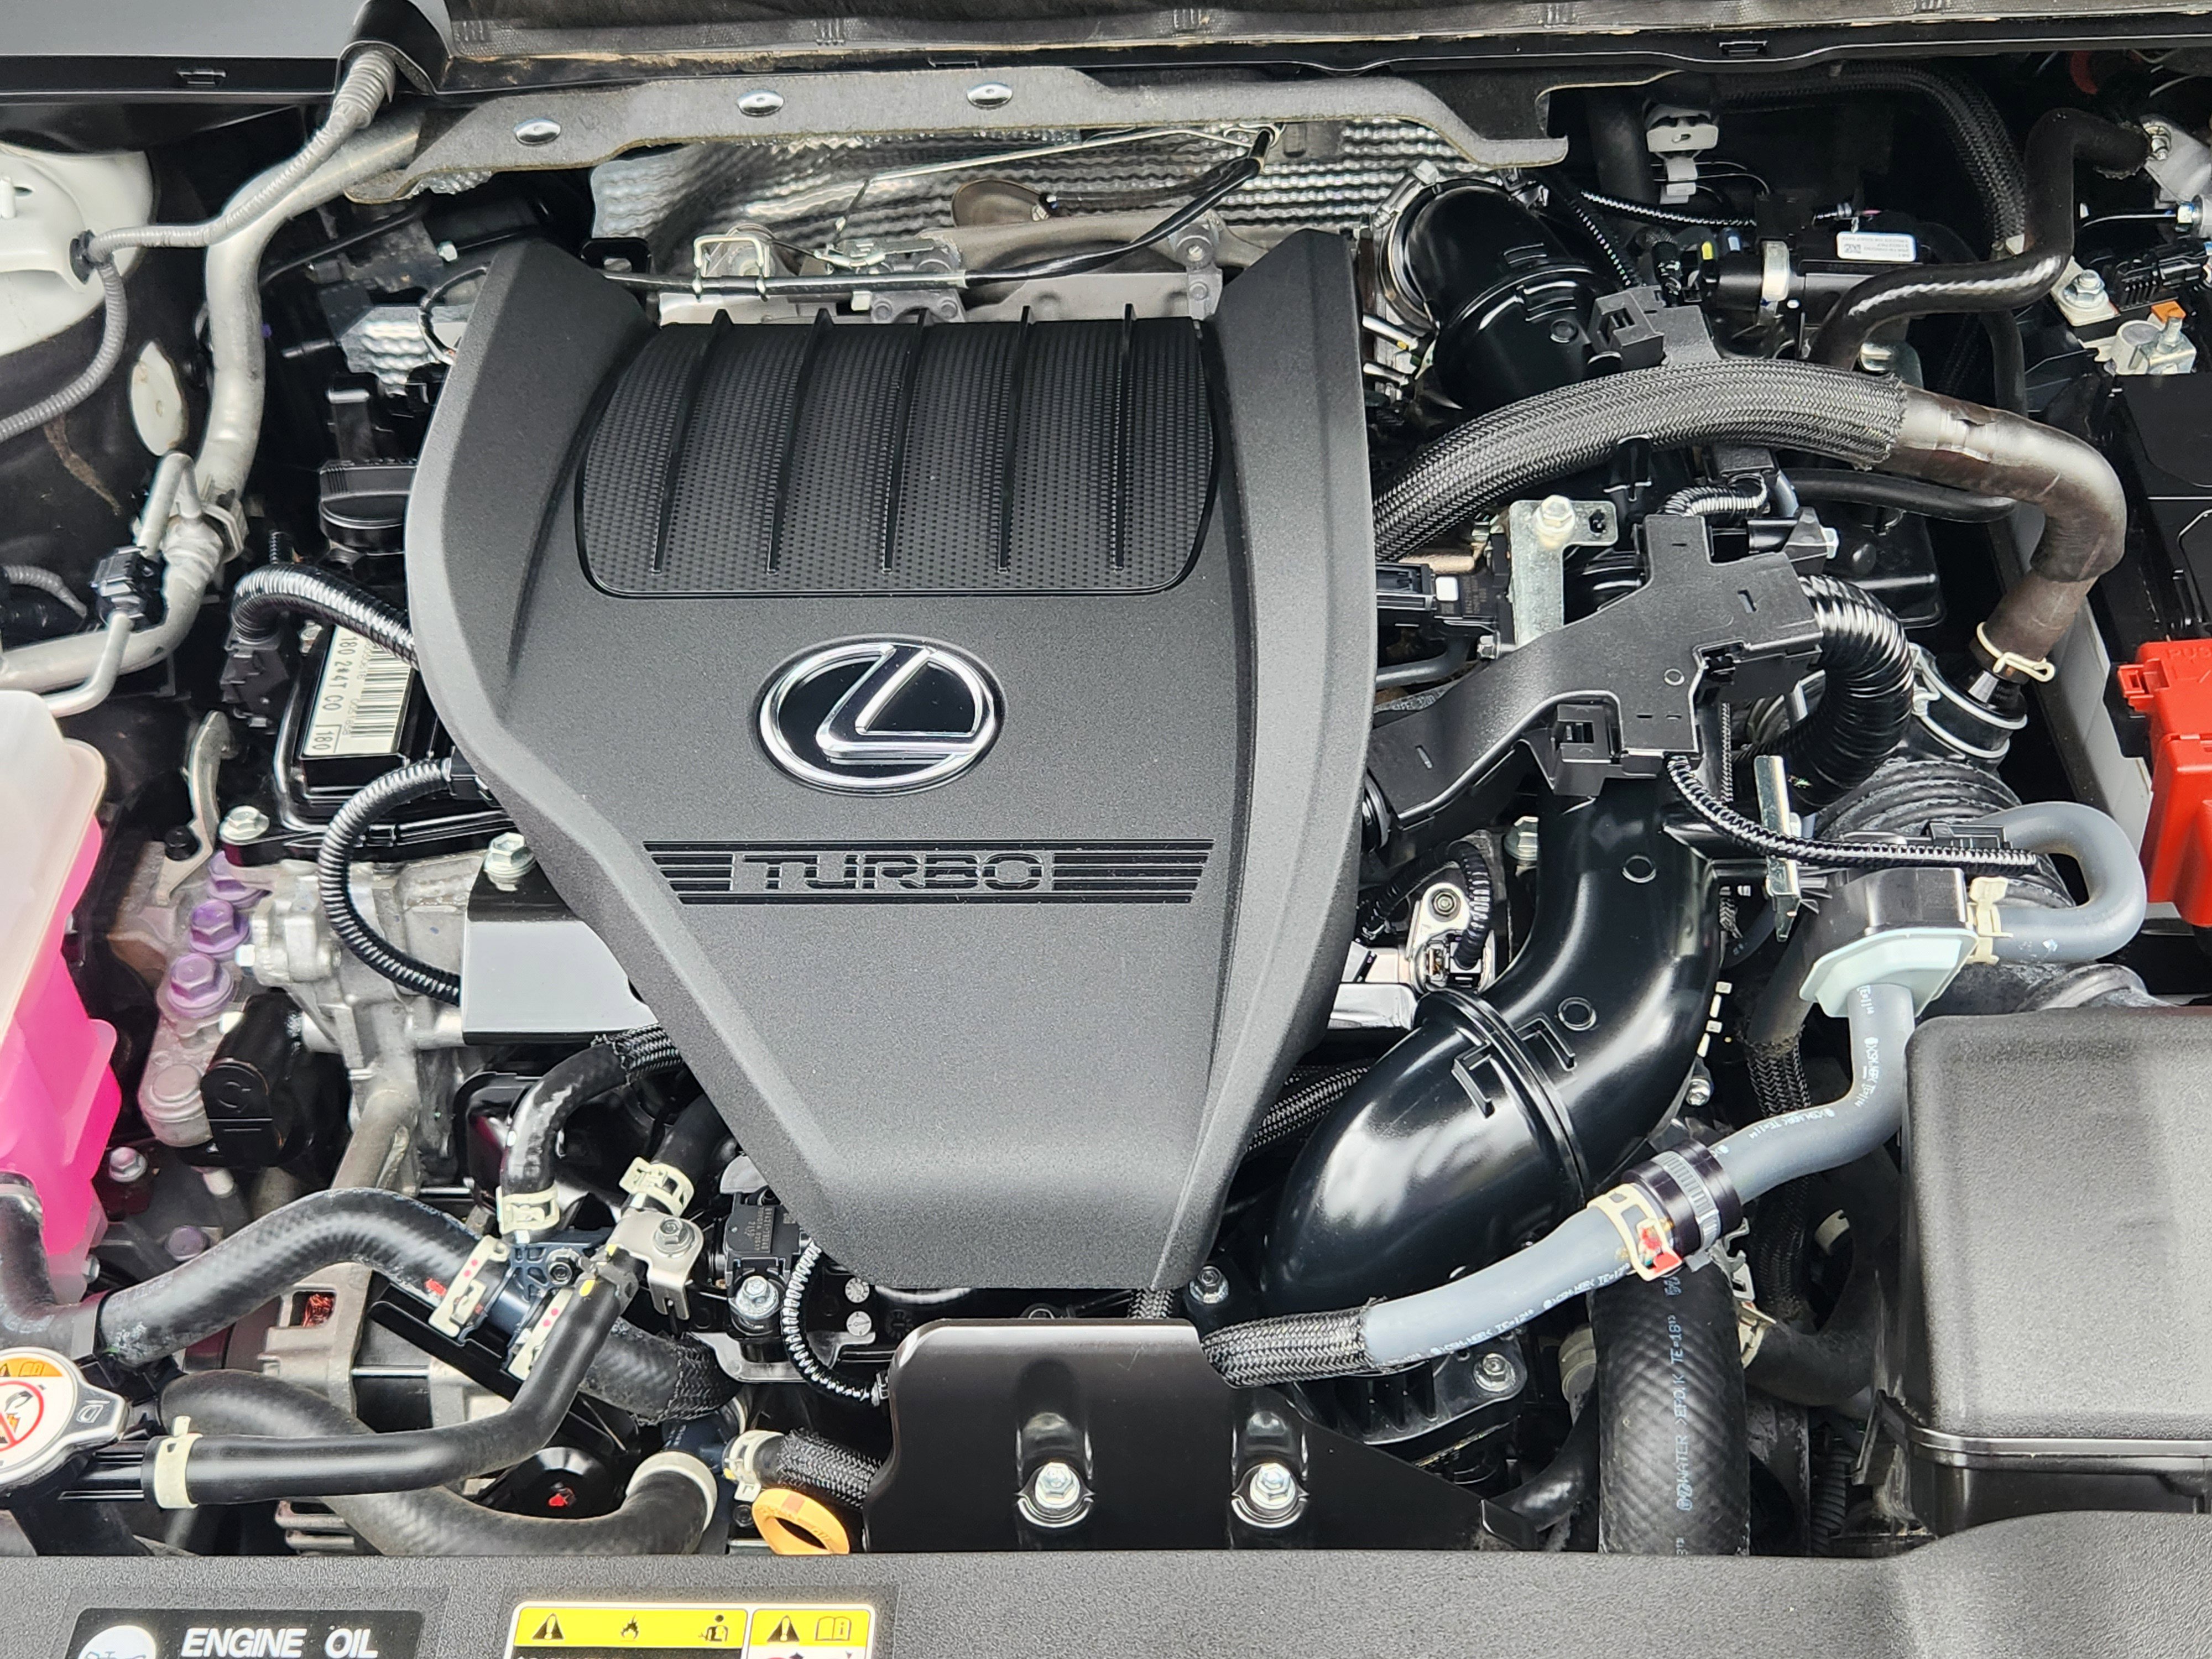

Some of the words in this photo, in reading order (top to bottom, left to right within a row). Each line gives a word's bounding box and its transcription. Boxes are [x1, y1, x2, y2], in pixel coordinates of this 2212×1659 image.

[337, 637, 358, 655] 180
[312, 731, 335, 750] 180
[743, 852, 1044, 890] TURBO
[1676, 1434, 1688, 1484] WATER
[181, 1628, 307, 1658] ENGINE
[324, 1628, 379, 1658] OIL
